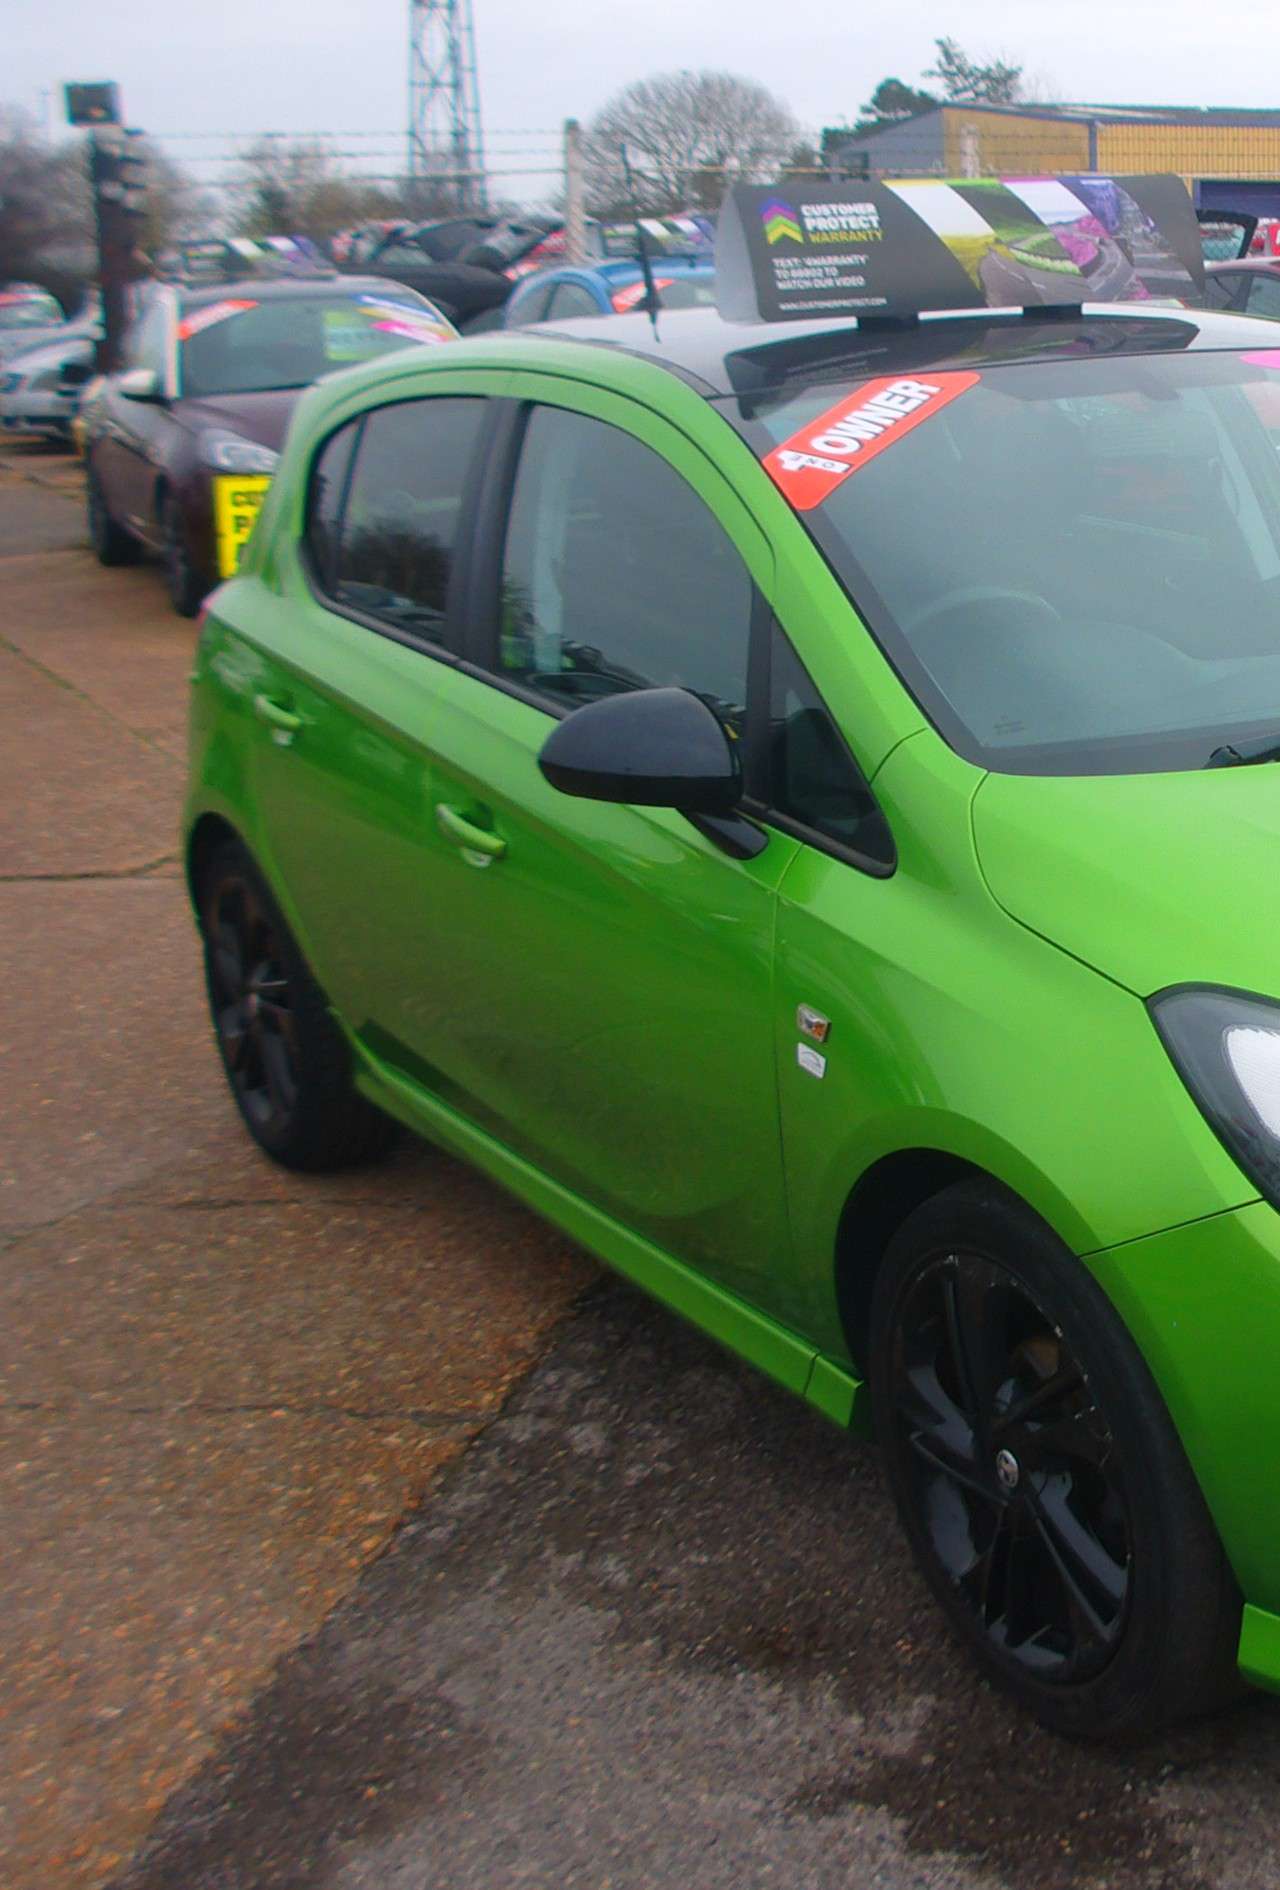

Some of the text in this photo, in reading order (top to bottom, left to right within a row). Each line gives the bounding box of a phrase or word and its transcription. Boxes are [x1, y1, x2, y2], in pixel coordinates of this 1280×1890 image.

[801, 202, 878, 216] CUSTOMER
[804, 215, 880, 231] PROTECT
[808, 230, 882, 243] WARRANTY
[809, 378, 943, 456] OWNER
